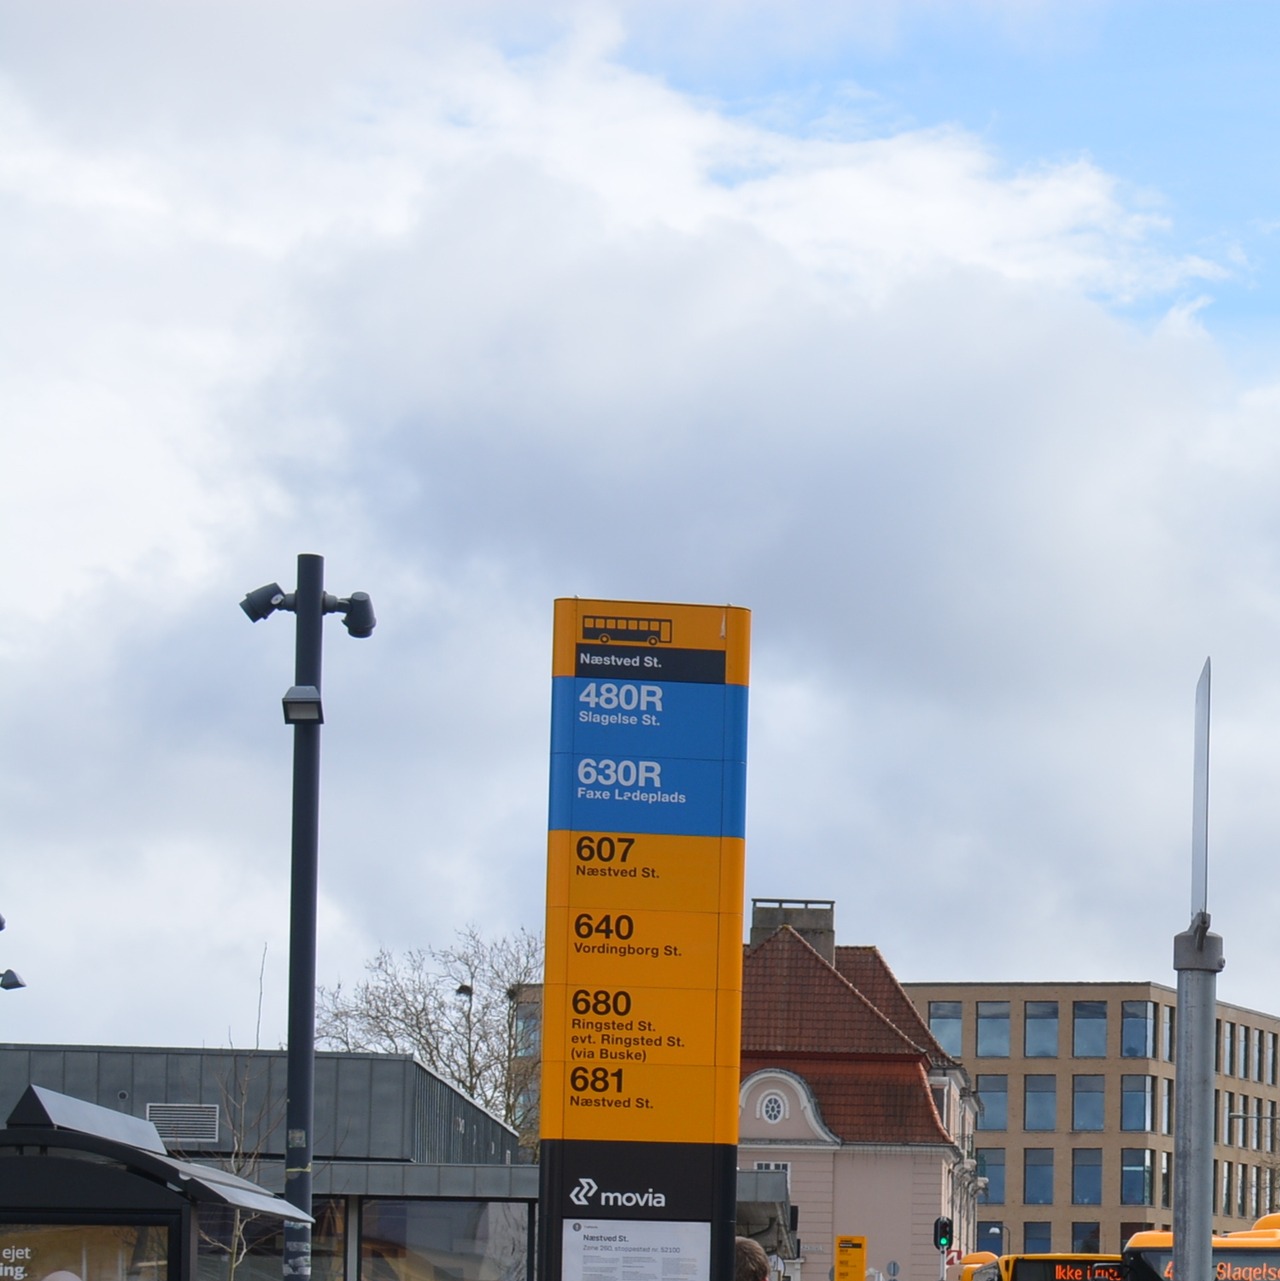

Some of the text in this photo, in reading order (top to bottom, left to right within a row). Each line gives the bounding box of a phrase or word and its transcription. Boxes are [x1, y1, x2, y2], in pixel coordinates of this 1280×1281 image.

[580, 652, 662, 668] Næstved St.
[579, 682, 663, 712] 480R
[579, 710, 660, 726] Slagelse St.
[577, 758, 661, 787] 630R
[577, 787, 611, 800] Faxe
[576, 836, 635, 863] 607
[576, 864, 660, 879] Næstved St.
[574, 913, 634, 940] 640
[574, 943, 682, 958] Vordingborg St.
[571, 990, 632, 1016] 680
[571, 1019, 656, 1032] Ringsted St.
[571, 1034, 685, 1048] evt. Ringsted St.
[571, 1048, 647, 1063] (via Buske)
[570, 1066, 624, 1093] 681
[570, 1096, 654, 1109] Næstved St.
[601, 1188, 666, 1207] movia
[583, 1234, 617, 1242] Næstved
[2, 1245, 31, 1263] ejet
[1055, 1264, 1082, 1280] Ikke
